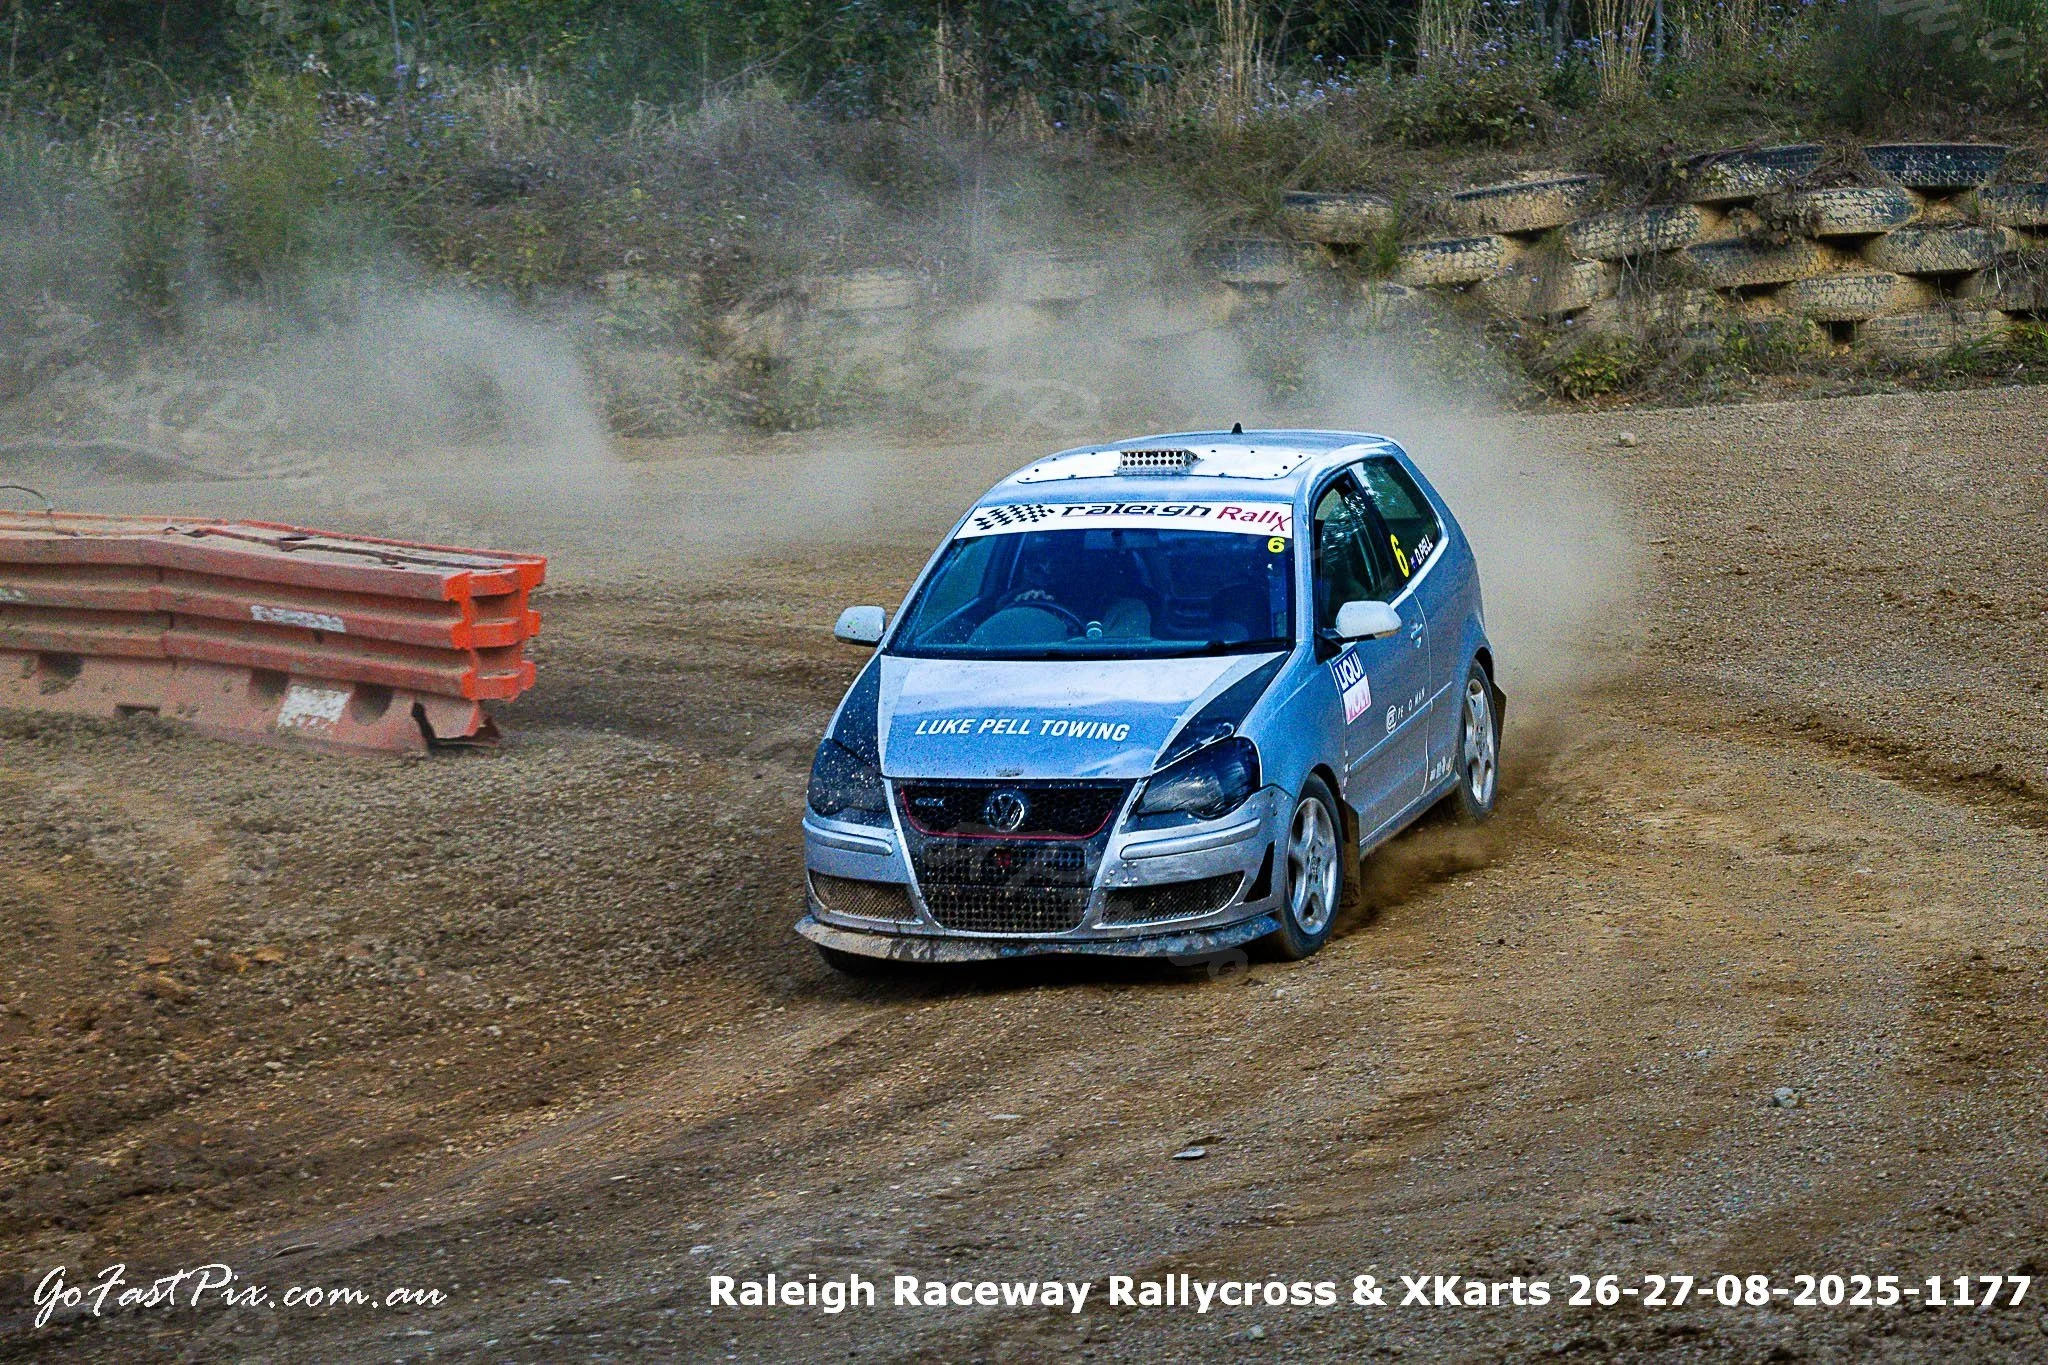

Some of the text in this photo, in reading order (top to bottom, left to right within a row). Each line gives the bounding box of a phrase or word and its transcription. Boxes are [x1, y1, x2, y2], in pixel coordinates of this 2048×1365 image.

[1061, 503, 1212, 518] raleigh
[1268, 536, 1285, 553] 6
[1390, 534, 1410, 578] 6
[1334, 651, 1364, 692] LIQUI
[915, 718, 1131, 742] LUKE PELL TOWING
